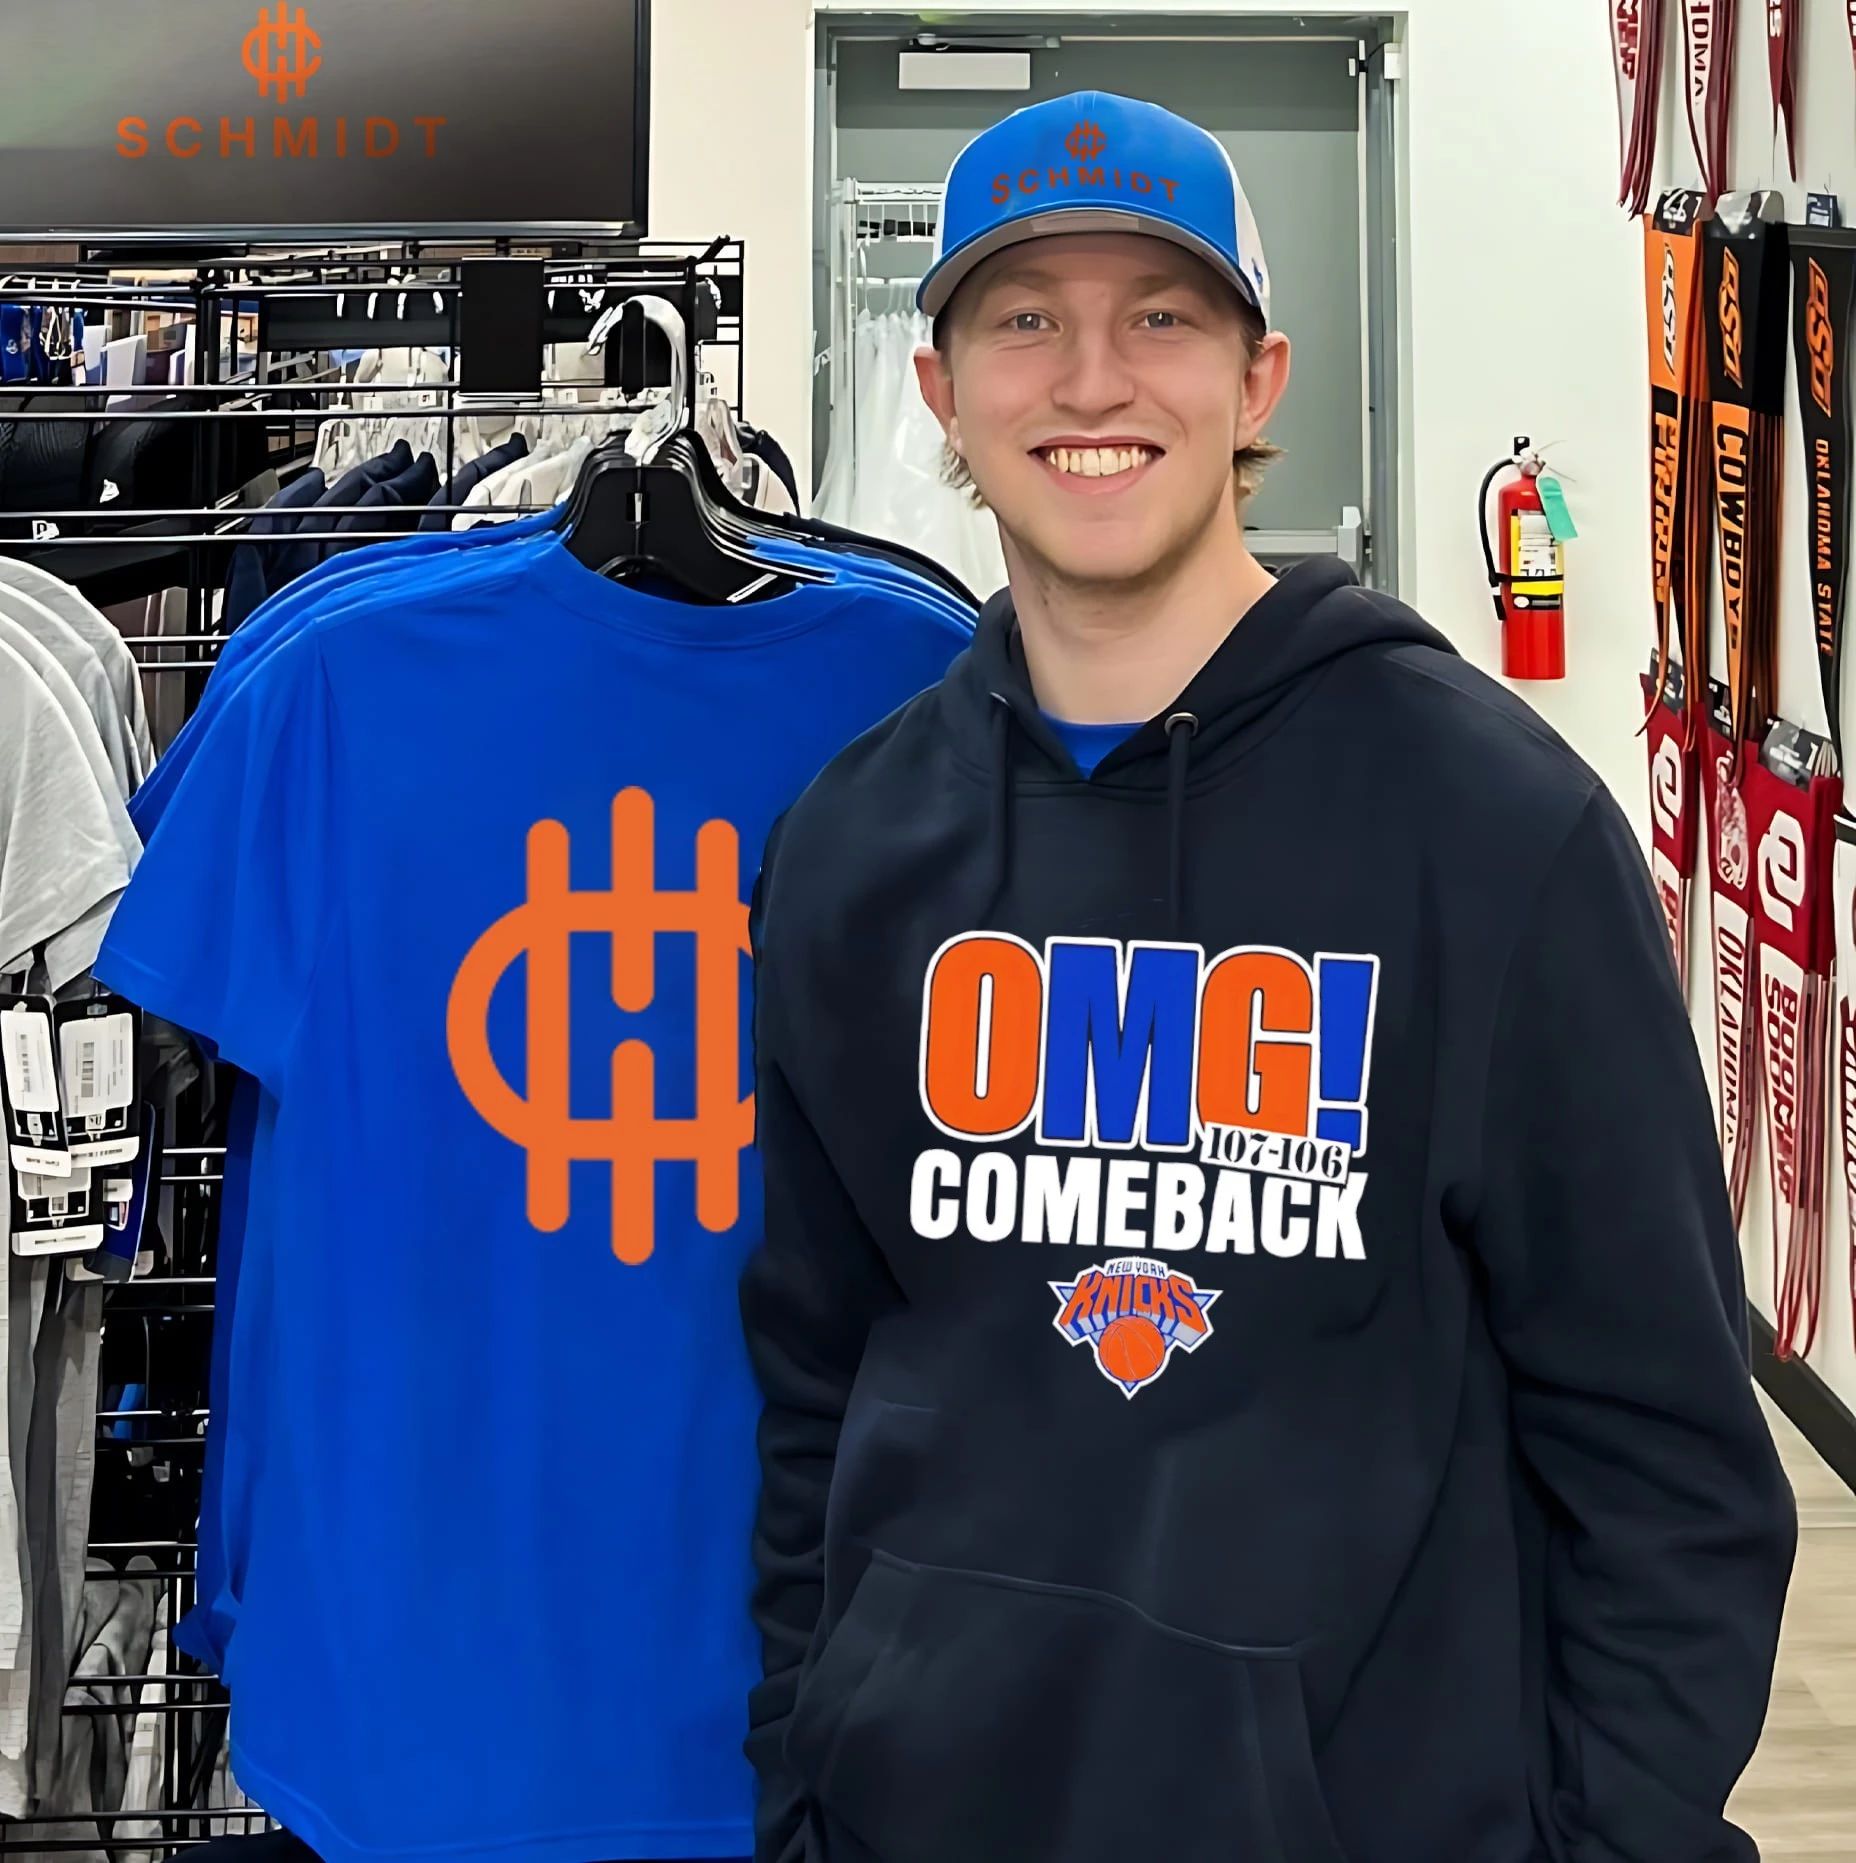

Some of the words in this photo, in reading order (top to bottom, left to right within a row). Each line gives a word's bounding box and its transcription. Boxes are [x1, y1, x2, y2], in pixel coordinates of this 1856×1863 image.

[115, 116, 448, 159] SCHMIDT
[991, 166, 1180, 205] SCHMIDT
[1814, 438, 1832, 571] OKLAHOMA
[918, 930, 1381, 1158] OMG!
[1206, 1126, 1346, 1180] 107-106
[909, 1148, 1369, 1260] COMEBACK
[1106, 1261, 1133, 1275] NEW
[1134, 1262, 1166, 1278] YORK
[1058, 1270, 1209, 1336] KNICKS
